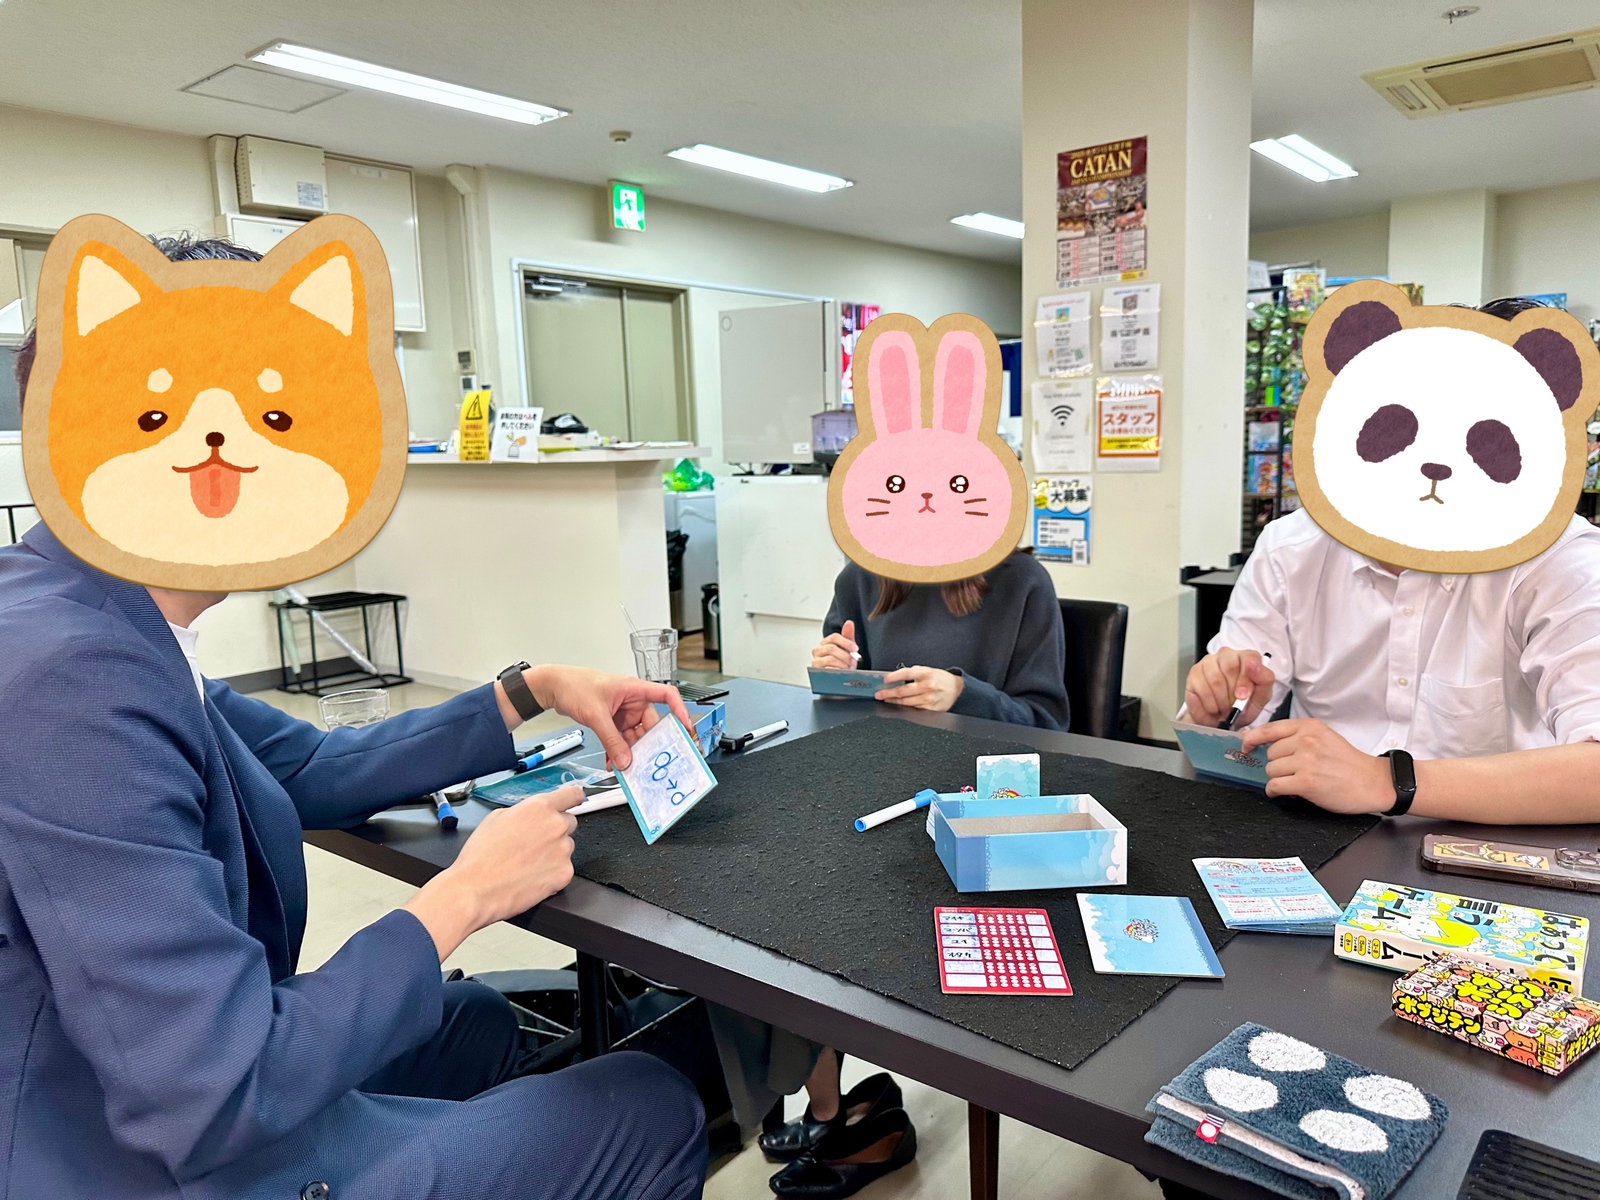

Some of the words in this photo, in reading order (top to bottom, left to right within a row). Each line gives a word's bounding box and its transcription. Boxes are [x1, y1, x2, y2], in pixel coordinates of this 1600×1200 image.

[1070, 150, 1132, 179] CATAN
[1103, 411, 1156, 426] スタッフ
[1372, 887, 1425, 921] ゲーム
[1454, 898, 1499, 926] 言う
[1534, 911, 1583, 971] はぁって
[1398, 995, 1482, 1034] ボブジテン
